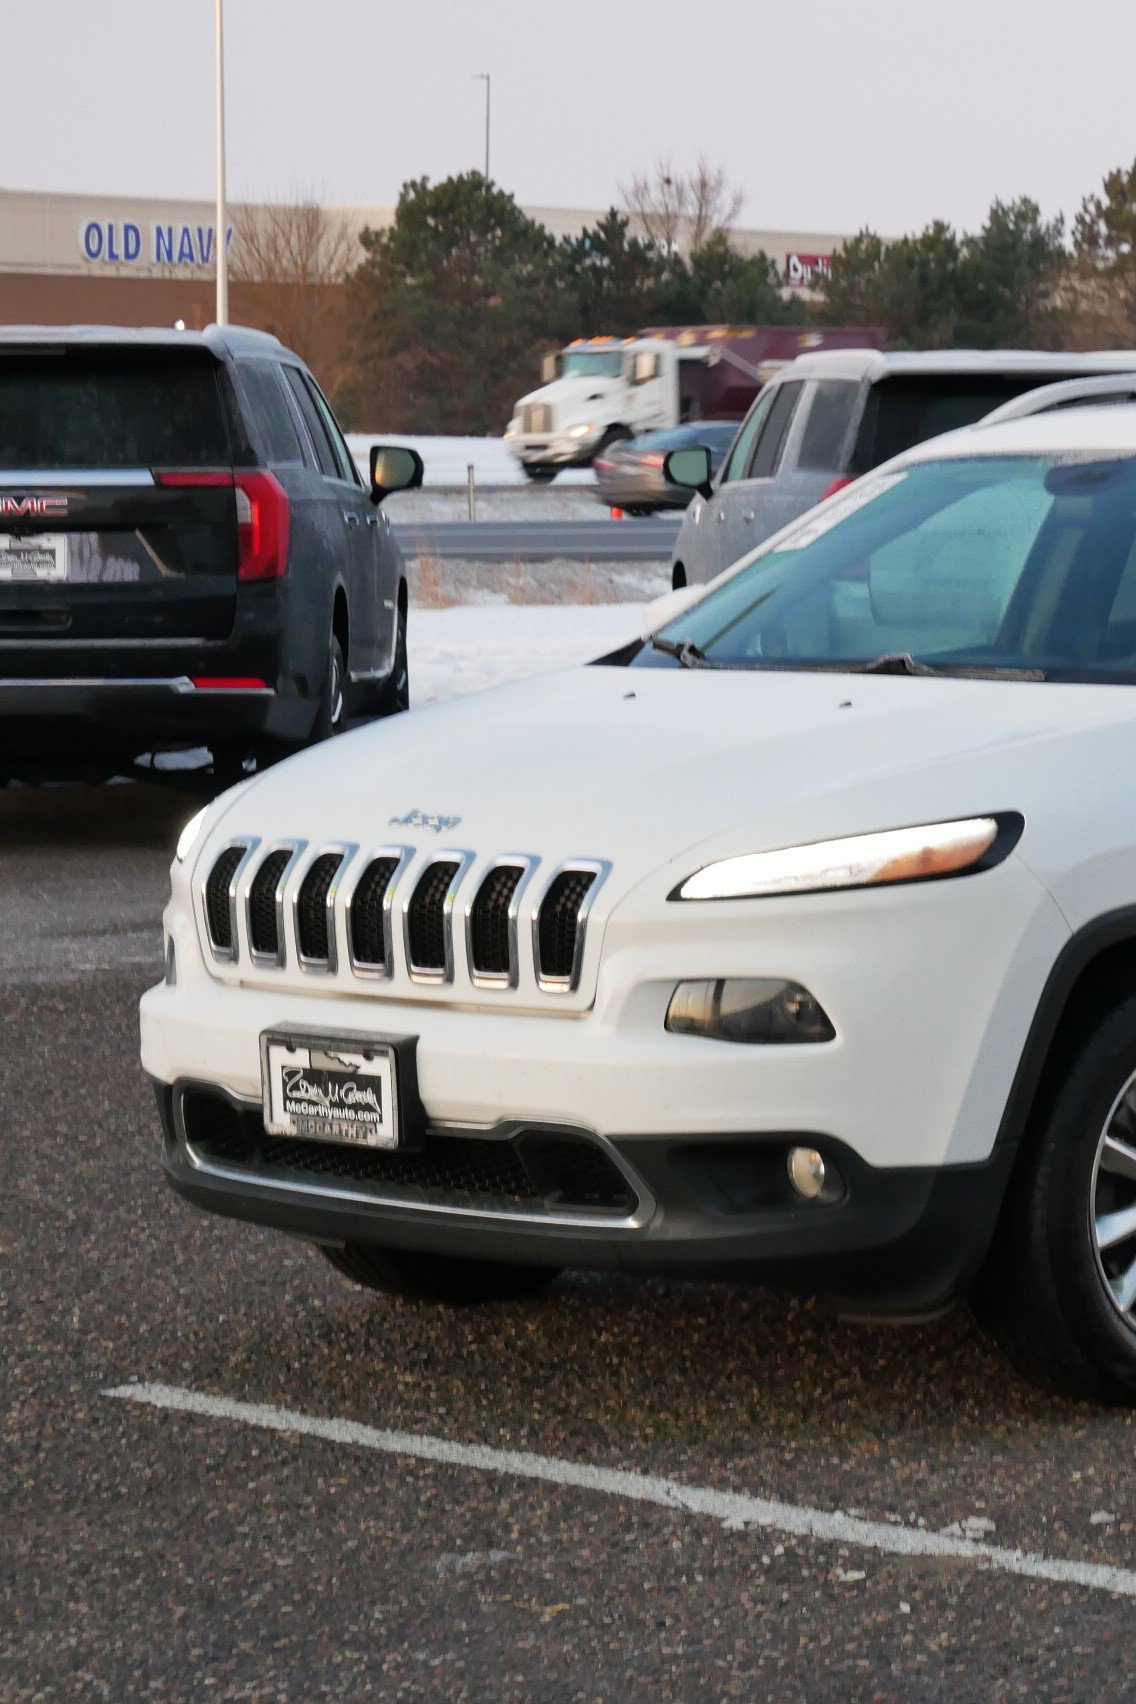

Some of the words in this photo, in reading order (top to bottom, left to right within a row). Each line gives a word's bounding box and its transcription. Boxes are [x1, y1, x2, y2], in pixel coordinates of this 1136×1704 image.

[84, 221, 141, 261] OLD
[0, 497, 69, 517] MC
[286, 1099, 380, 1123] McCarthyauto.com
